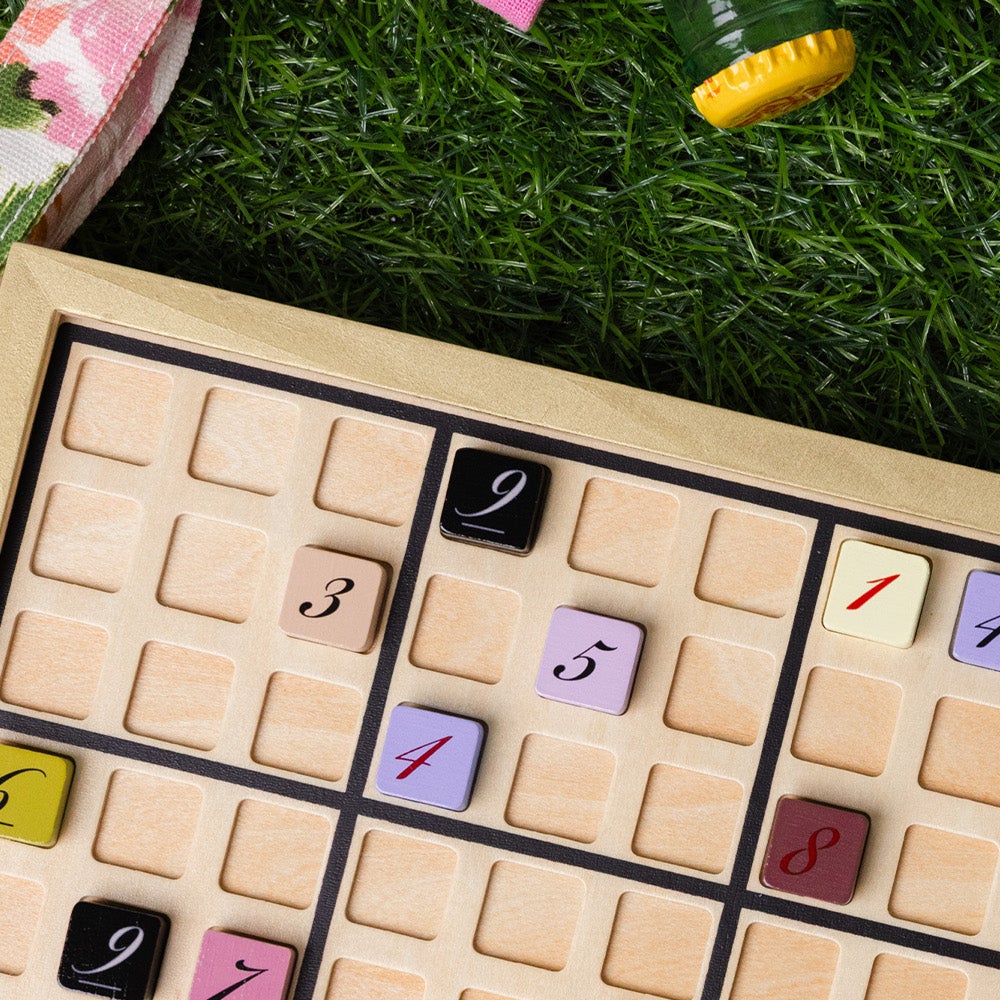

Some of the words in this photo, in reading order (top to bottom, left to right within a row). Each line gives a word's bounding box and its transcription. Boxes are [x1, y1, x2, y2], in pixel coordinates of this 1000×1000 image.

[454, 470, 527, 534] 9
[299, 577, 355, 618] 3
[846, 574, 901, 610] 1
[553, 640, 618, 680] 5
[395, 736, 453, 779] 4
[780, 827, 840, 875] 8
[71, 926, 145, 991] 9
